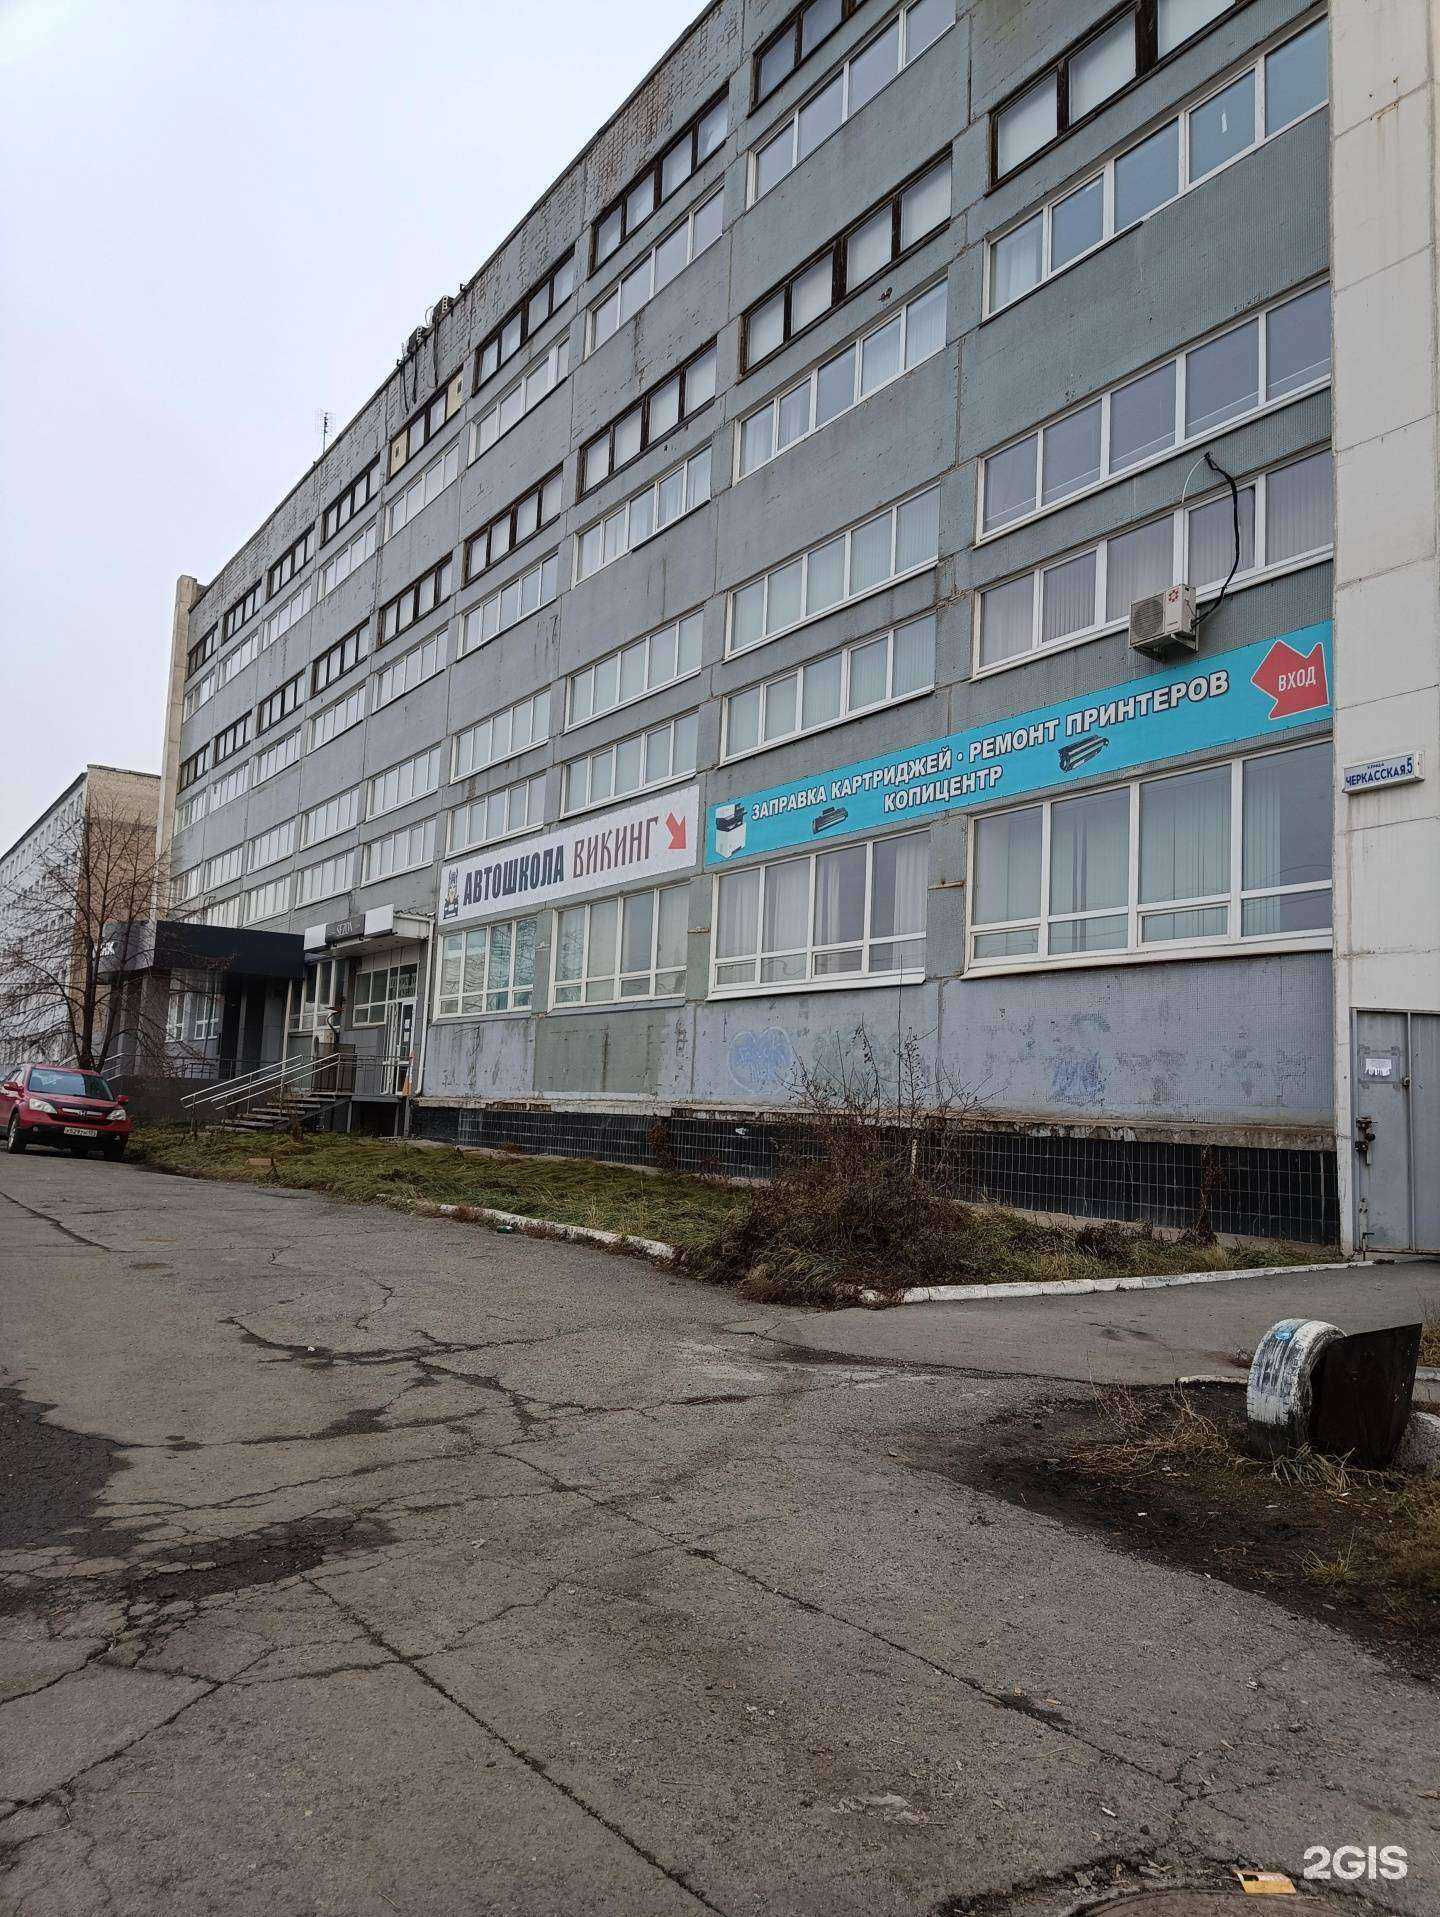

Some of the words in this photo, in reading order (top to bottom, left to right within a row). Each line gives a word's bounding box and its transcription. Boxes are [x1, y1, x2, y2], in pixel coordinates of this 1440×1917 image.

[1278, 667, 1316, 692] ВХОД
[751, 785, 827, 820] ЗАПРАВКА
[831, 747, 951, 800] КАРТРИДЖЕЙ
[968, 718, 1060, 764] РЕМОНТ
[1066, 669, 1229, 737] ПРИНТЕРОВ
[883, 765, 1003, 814] КОПИЦЕНТР
[463, 845, 565, 906] АВТОШКОЛА
[573, 816, 659, 878] ВИКИНГ
